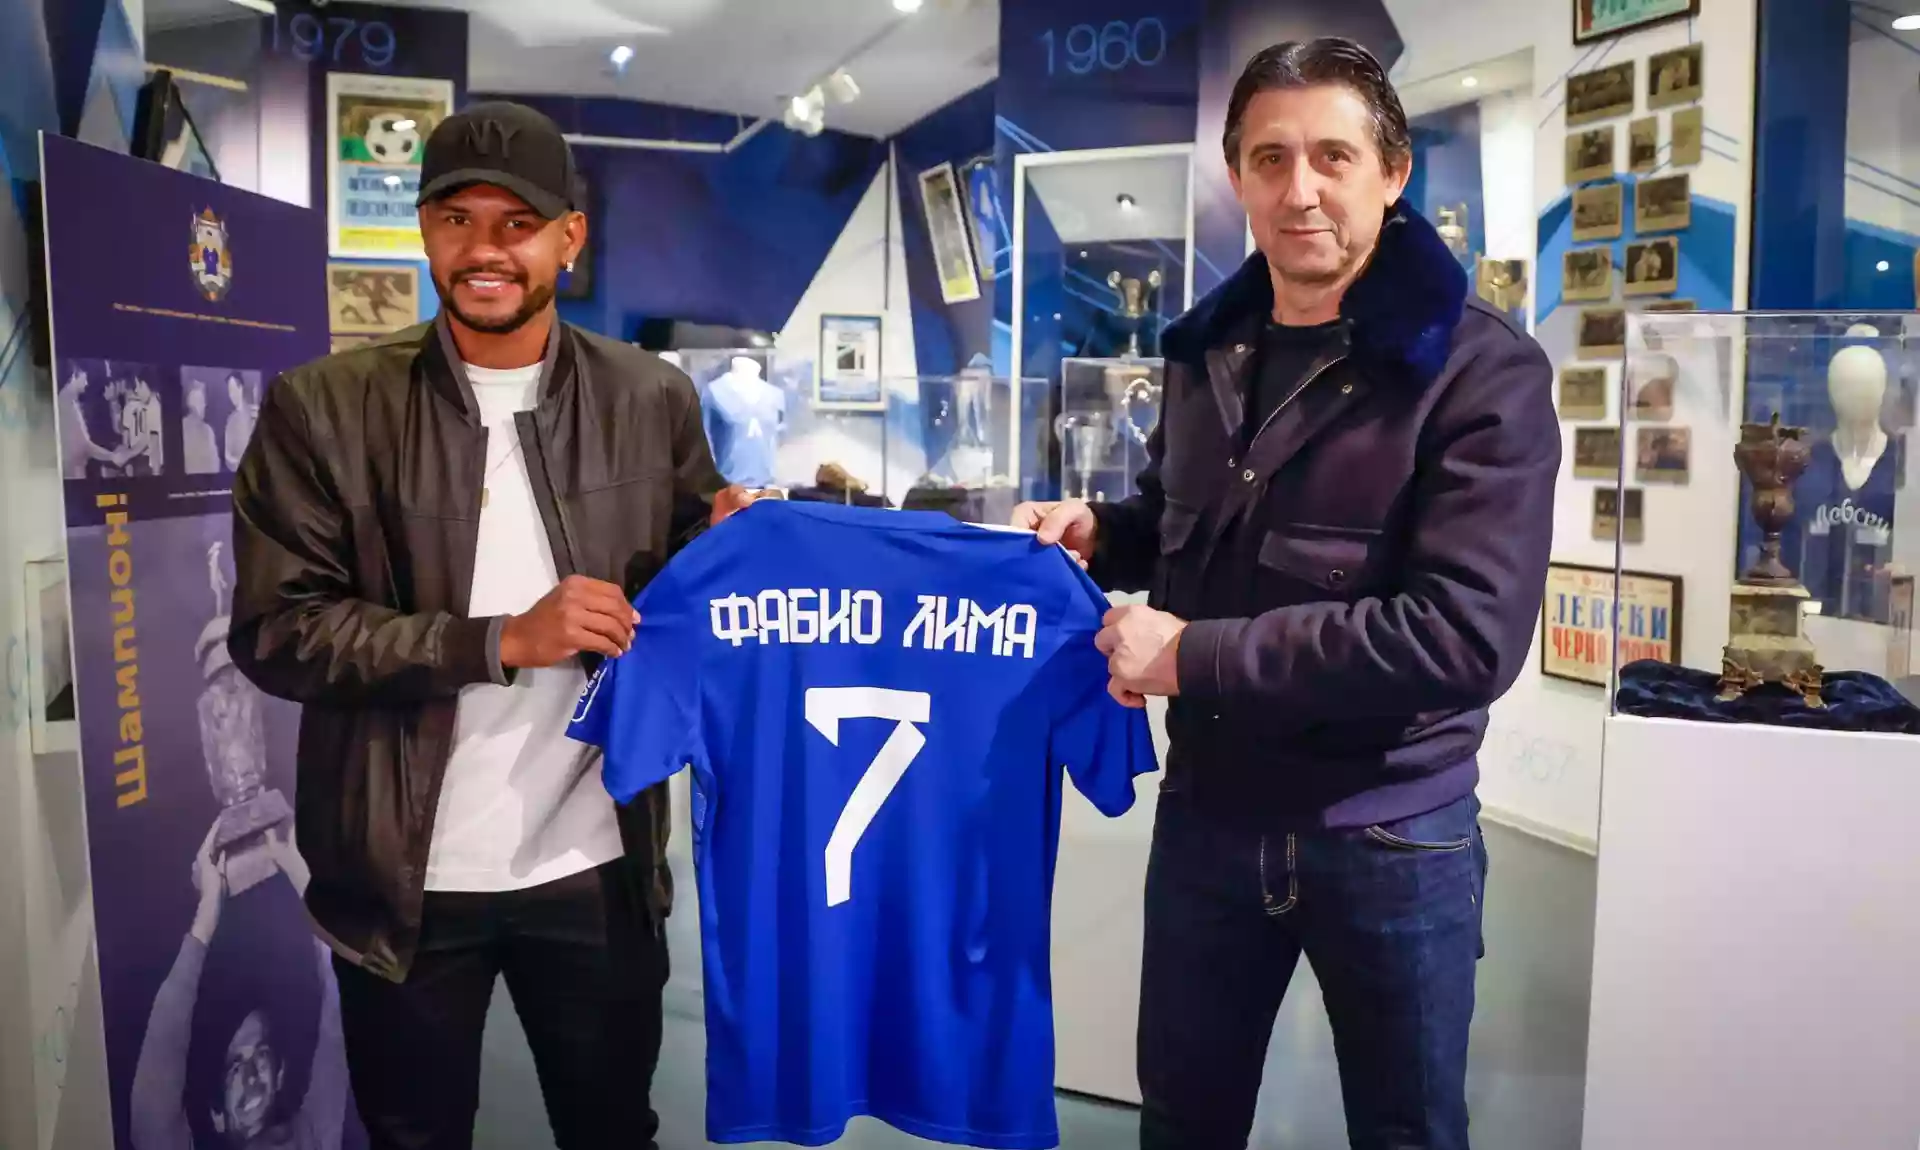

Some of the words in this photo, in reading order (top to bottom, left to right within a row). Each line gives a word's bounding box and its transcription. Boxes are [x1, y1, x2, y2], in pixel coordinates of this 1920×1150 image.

[266, 12, 396, 66] 1979
[1042, 17, 1166, 75] 1960
[466, 119, 522, 159] NY
[96, 494, 148, 809] Шампион!
[709, 588, 882, 646] ФАБИО
[902, 594, 1037, 658] ЛИМА
[1500, 728, 1577, 786] 967
[805, 686, 931, 908] 7
